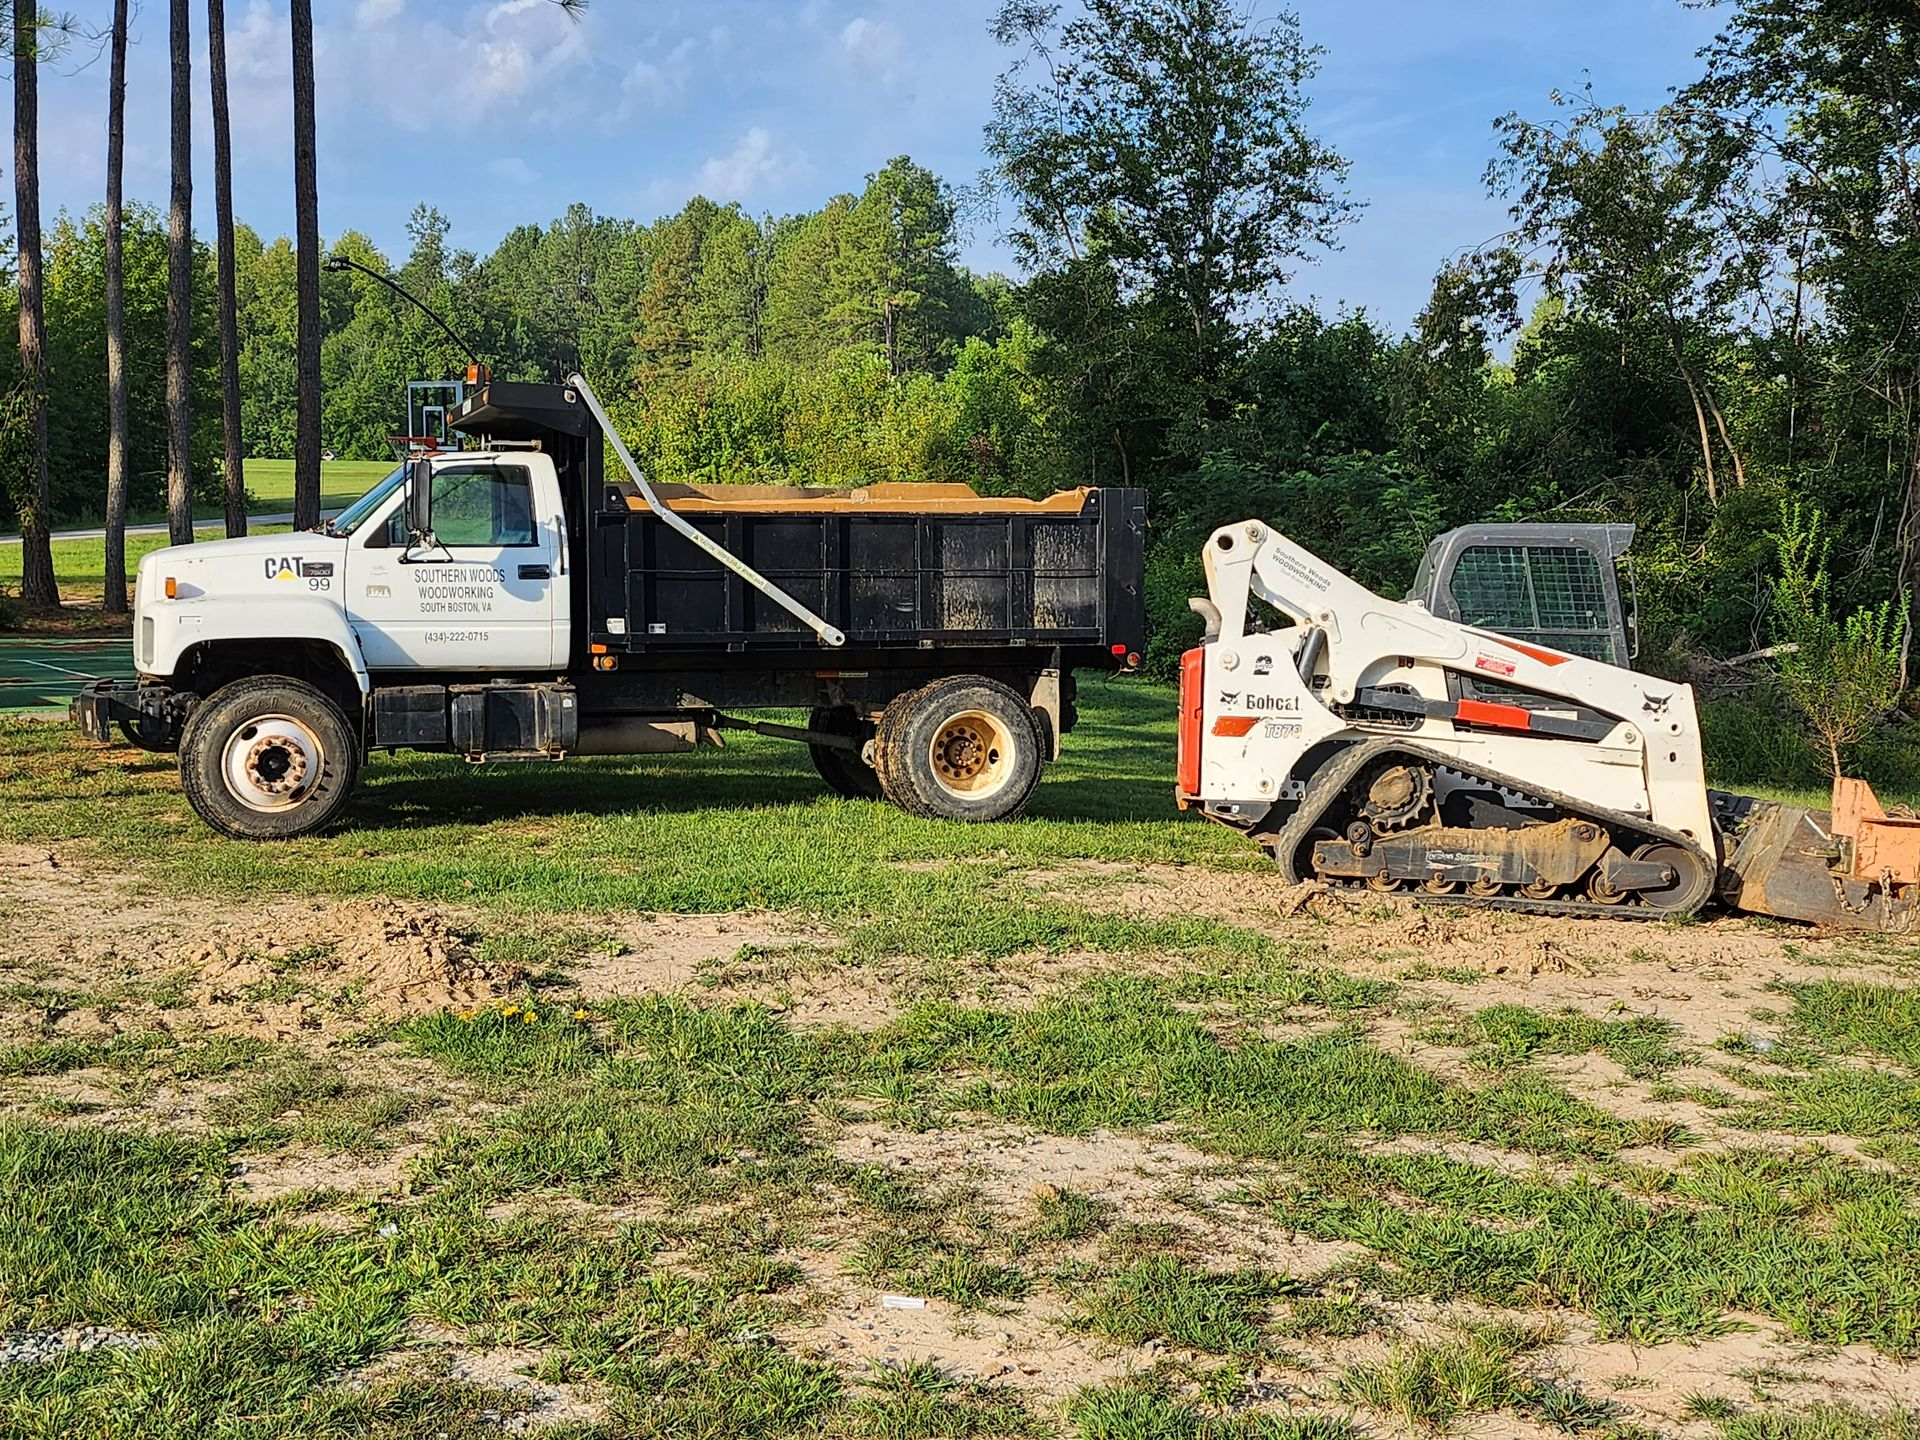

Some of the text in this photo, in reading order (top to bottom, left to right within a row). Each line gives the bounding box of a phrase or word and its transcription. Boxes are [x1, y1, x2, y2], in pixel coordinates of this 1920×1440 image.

[265, 557, 303, 579] CAT
[1272, 554, 1327, 592] WOODWORKING
[1275, 547, 1307, 571] Southern
[1308, 566, 1332, 587] Woods
[414, 569, 506, 583] SOUTHERN WOODS
[308, 578, 331, 591] 99
[418, 586, 494, 599] WOODWORKING
[420, 602, 492, 614] SOUTH BOSTON, VA
[424, 631, 489, 643] (434)-222-0715
[1246, 694, 1300, 710] Bobcat
